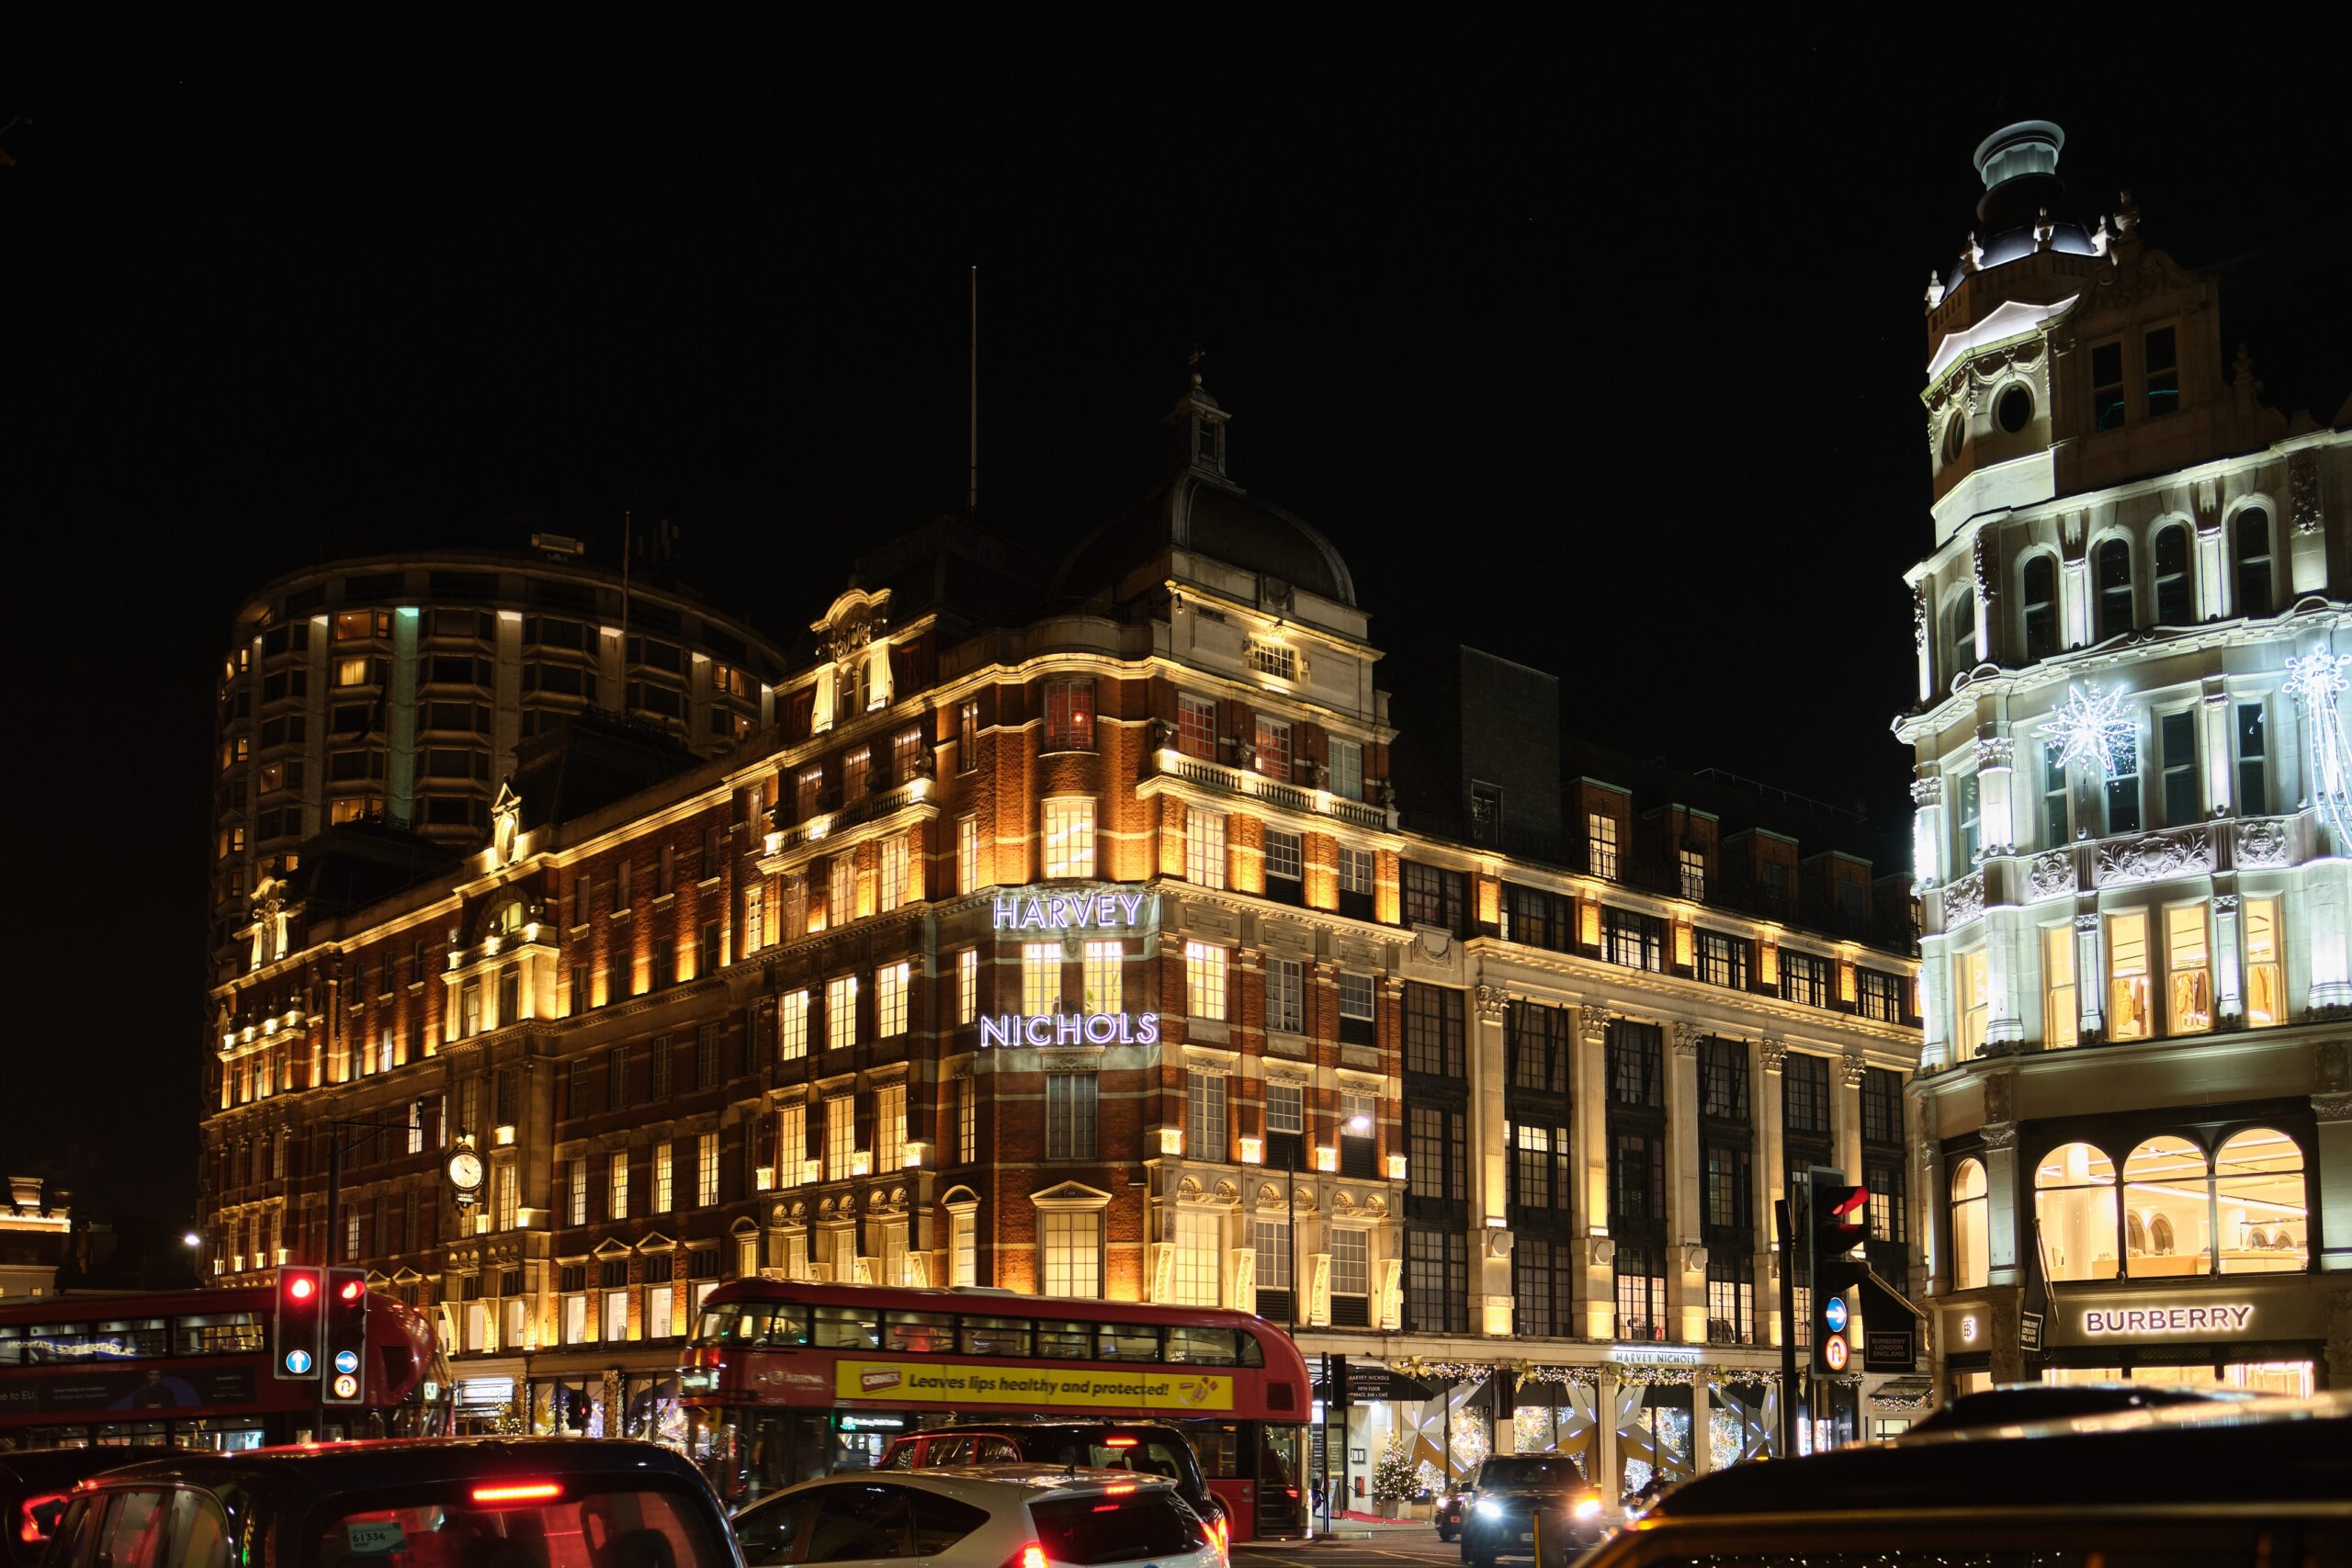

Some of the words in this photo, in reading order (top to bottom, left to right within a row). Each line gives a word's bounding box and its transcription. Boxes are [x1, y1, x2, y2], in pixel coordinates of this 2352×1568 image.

[993, 894, 1143, 929] HARVEY
[980, 1012, 1159, 1047] NICHOLS
[2086, 1306, 2250, 1332] BURBERRY
[1616, 1352, 1653, 1363] HARVEY
[1657, 1353, 1696, 1364] NICHOLS
[909, 1374, 965, 1389] Leaves
[968, 1376, 996, 1393] lips
[999, 1377, 1057, 1395] healthy
[1061, 1380, 1090, 1393] and
[1091, 1381, 1170, 1397] protected!
[353, 1532, 386, 1542] 61336
